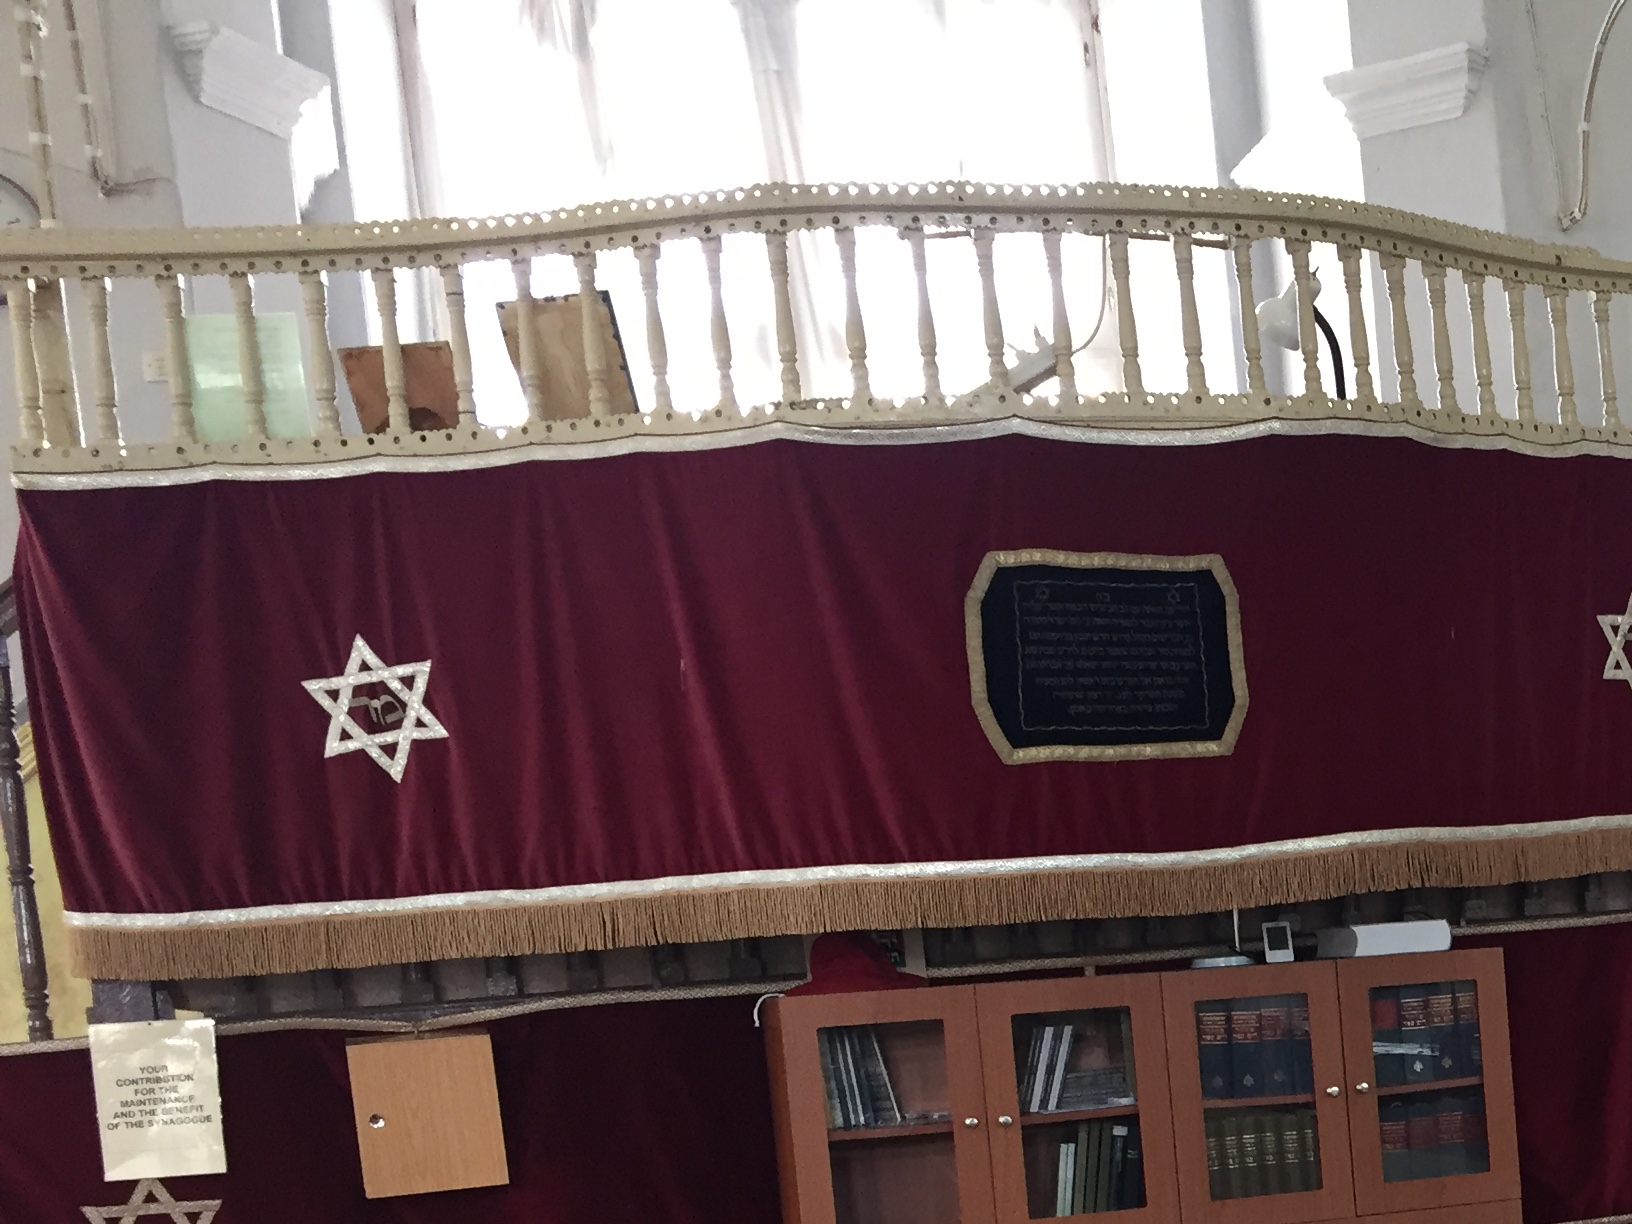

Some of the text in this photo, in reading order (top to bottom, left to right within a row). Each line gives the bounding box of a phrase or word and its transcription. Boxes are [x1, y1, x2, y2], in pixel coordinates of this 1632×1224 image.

[139, 1064, 168, 1074] YOUR
[115, 1074, 194, 1087] CONTRIBUTION
[134, 1085, 179, 1096] FOR THE
[120, 1094, 195, 1108] MAINTENANCE
[113, 1104, 204, 1120] AND THE BENEFIT
[107, 1114, 213, 1131] OF THE SYNAGOGUE
